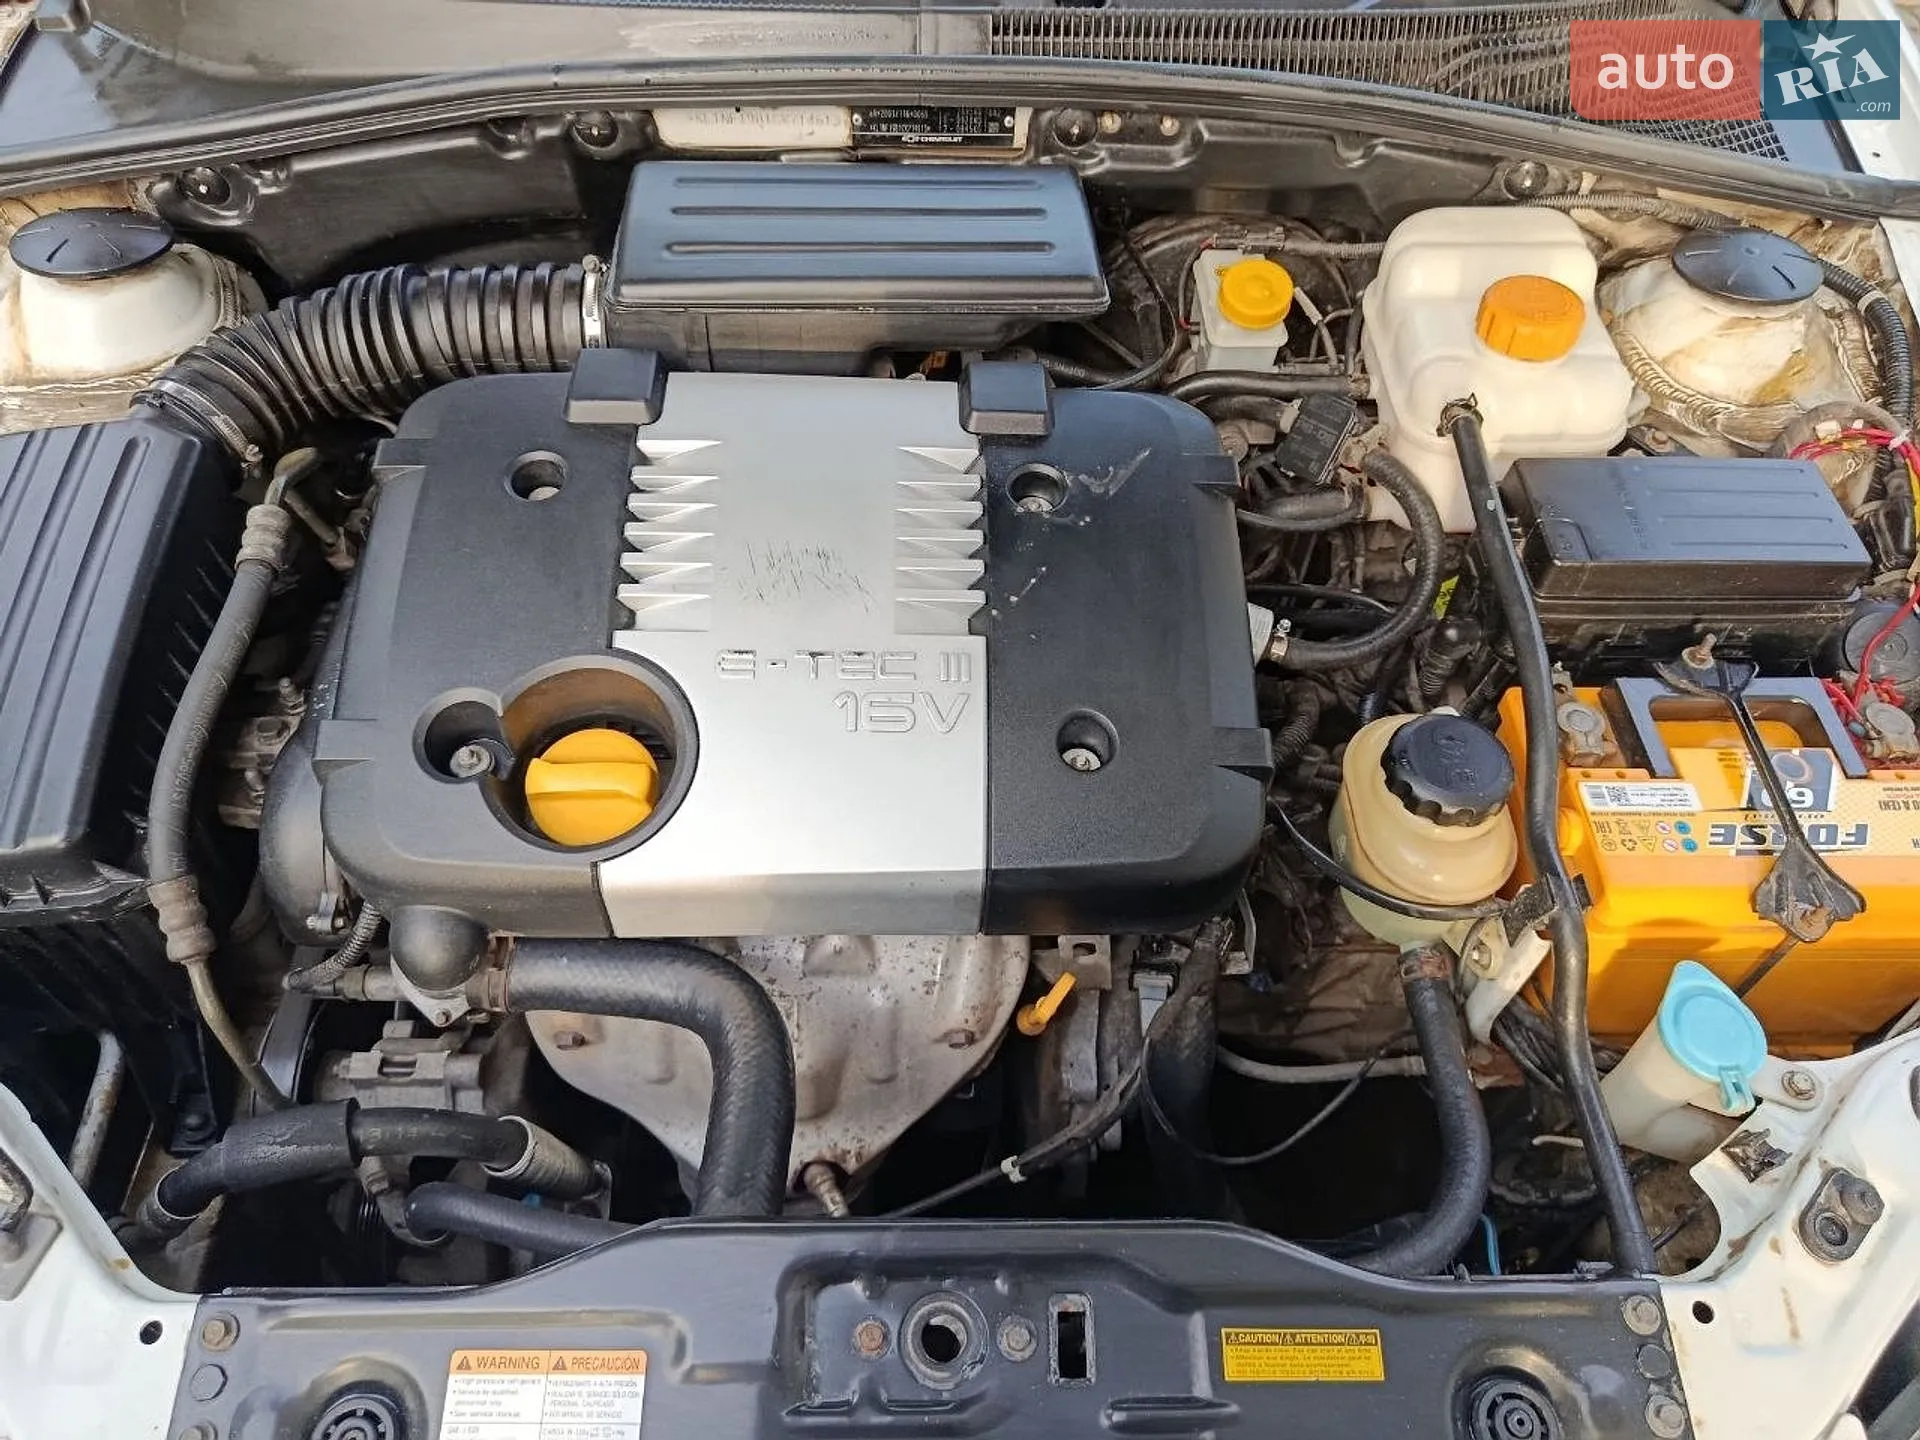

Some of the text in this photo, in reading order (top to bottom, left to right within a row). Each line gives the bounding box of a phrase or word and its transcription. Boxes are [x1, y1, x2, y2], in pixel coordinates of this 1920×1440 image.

[832, 689, 972, 734] 16V
[476, 1355, 541, 1370] WARNING
[571, 1355, 641, 1371] PRECAUCIÓN
